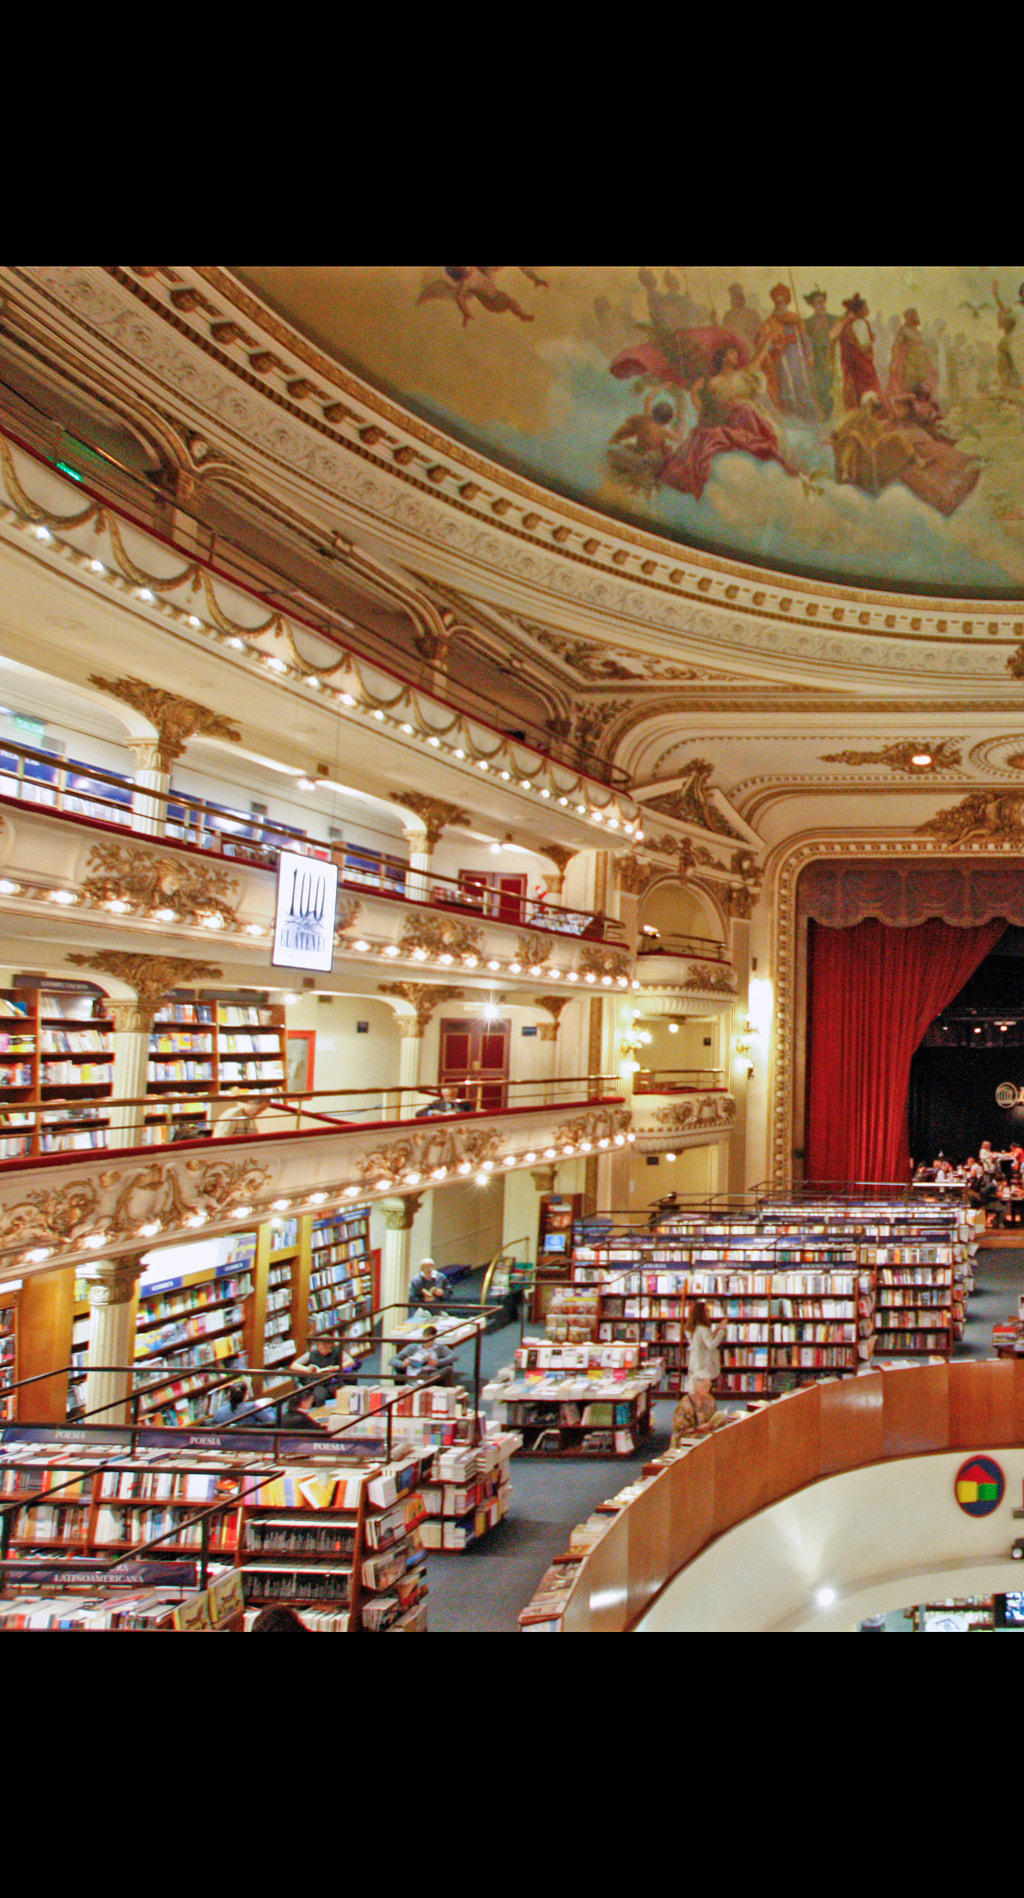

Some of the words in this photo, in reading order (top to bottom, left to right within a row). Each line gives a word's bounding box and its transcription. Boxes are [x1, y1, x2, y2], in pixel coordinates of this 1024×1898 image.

[289, 868, 326, 921] 100
[280, 929, 291, 948] EL
[55, 1430, 86, 1439] POESIA
[190, 1436, 221, 1445] POESIA
[313, 1442, 346, 1451] POESIA
[53, 1574, 144, 1583] LATINOAMERICANA
